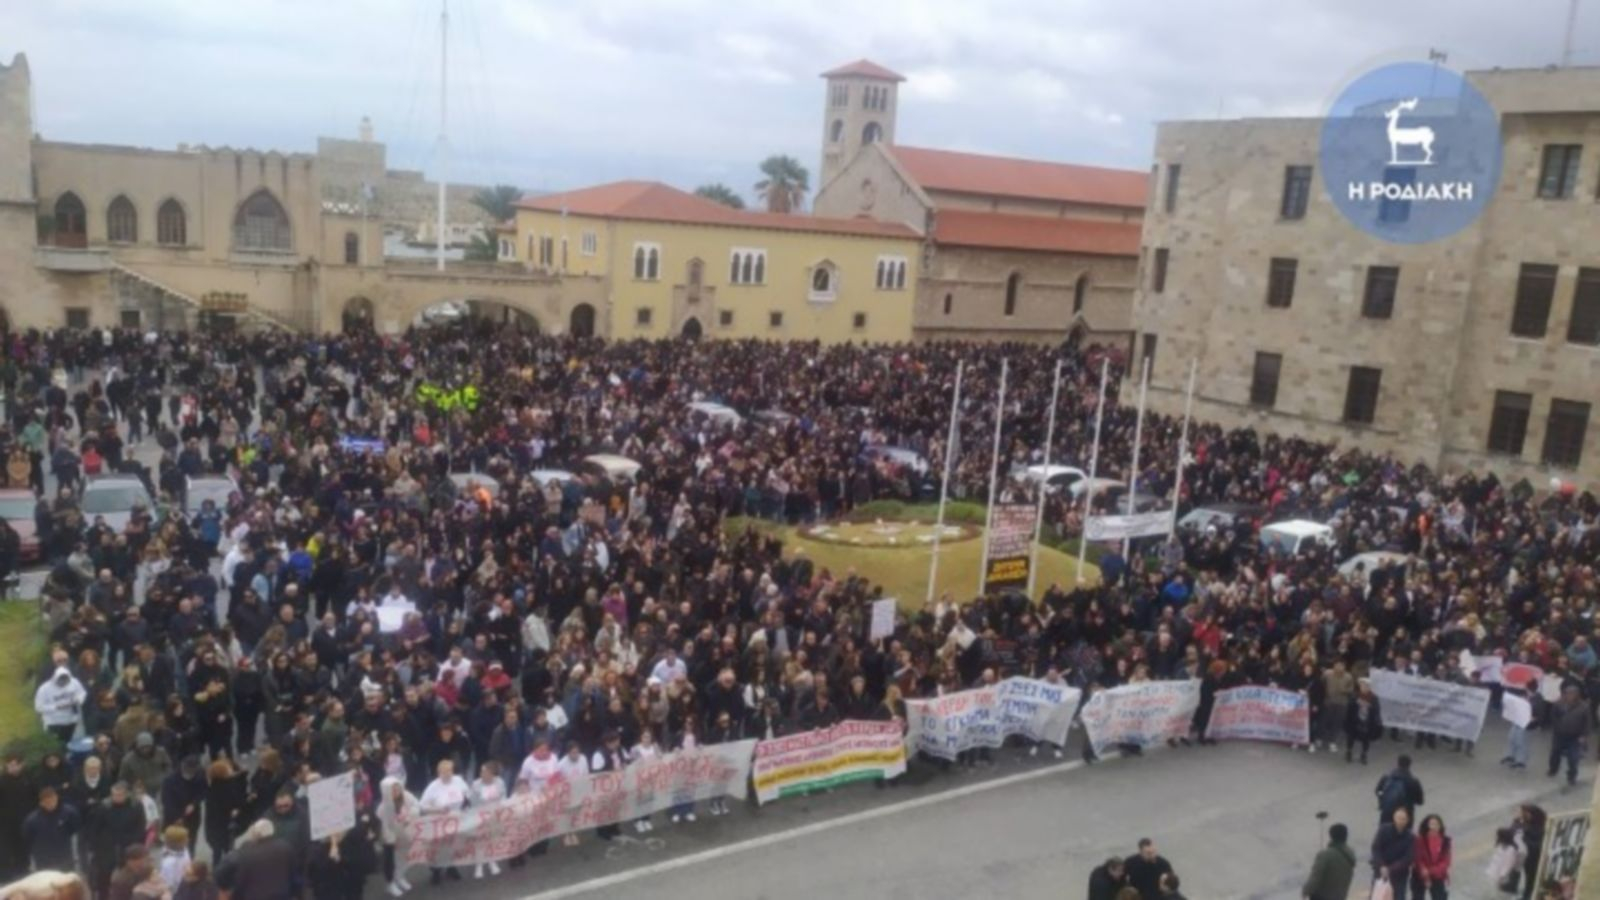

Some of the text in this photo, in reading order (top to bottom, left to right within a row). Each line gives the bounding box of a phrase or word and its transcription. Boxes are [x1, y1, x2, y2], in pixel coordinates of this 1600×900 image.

[1039, 687, 1063, 704] ΜΑΣ
[413, 816, 459, 841] ΣΤΟ
[591, 772, 625, 793] ΤΟΥ
